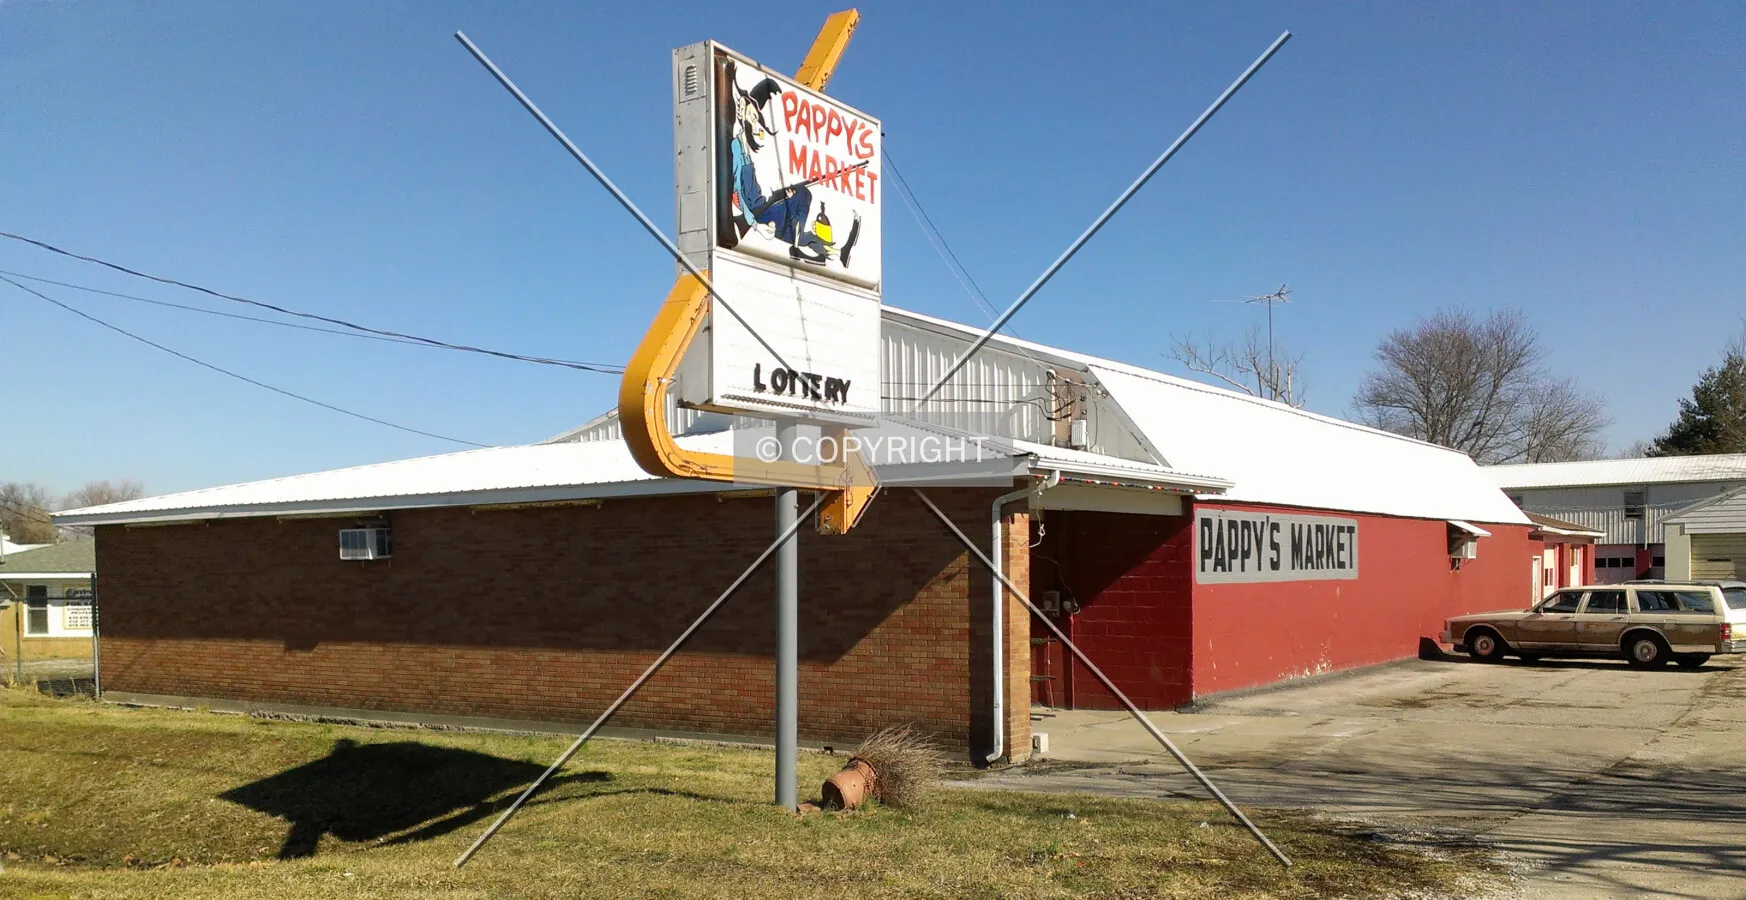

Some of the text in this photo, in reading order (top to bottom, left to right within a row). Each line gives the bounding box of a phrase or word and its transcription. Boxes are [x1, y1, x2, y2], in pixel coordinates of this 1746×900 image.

[781, 90, 875, 160] PAPPY'S
[789, 139, 878, 205] MARKET
[753, 363, 851, 404] LOTTERY
[1200, 515, 1356, 572] PAPPY'S MARKET
